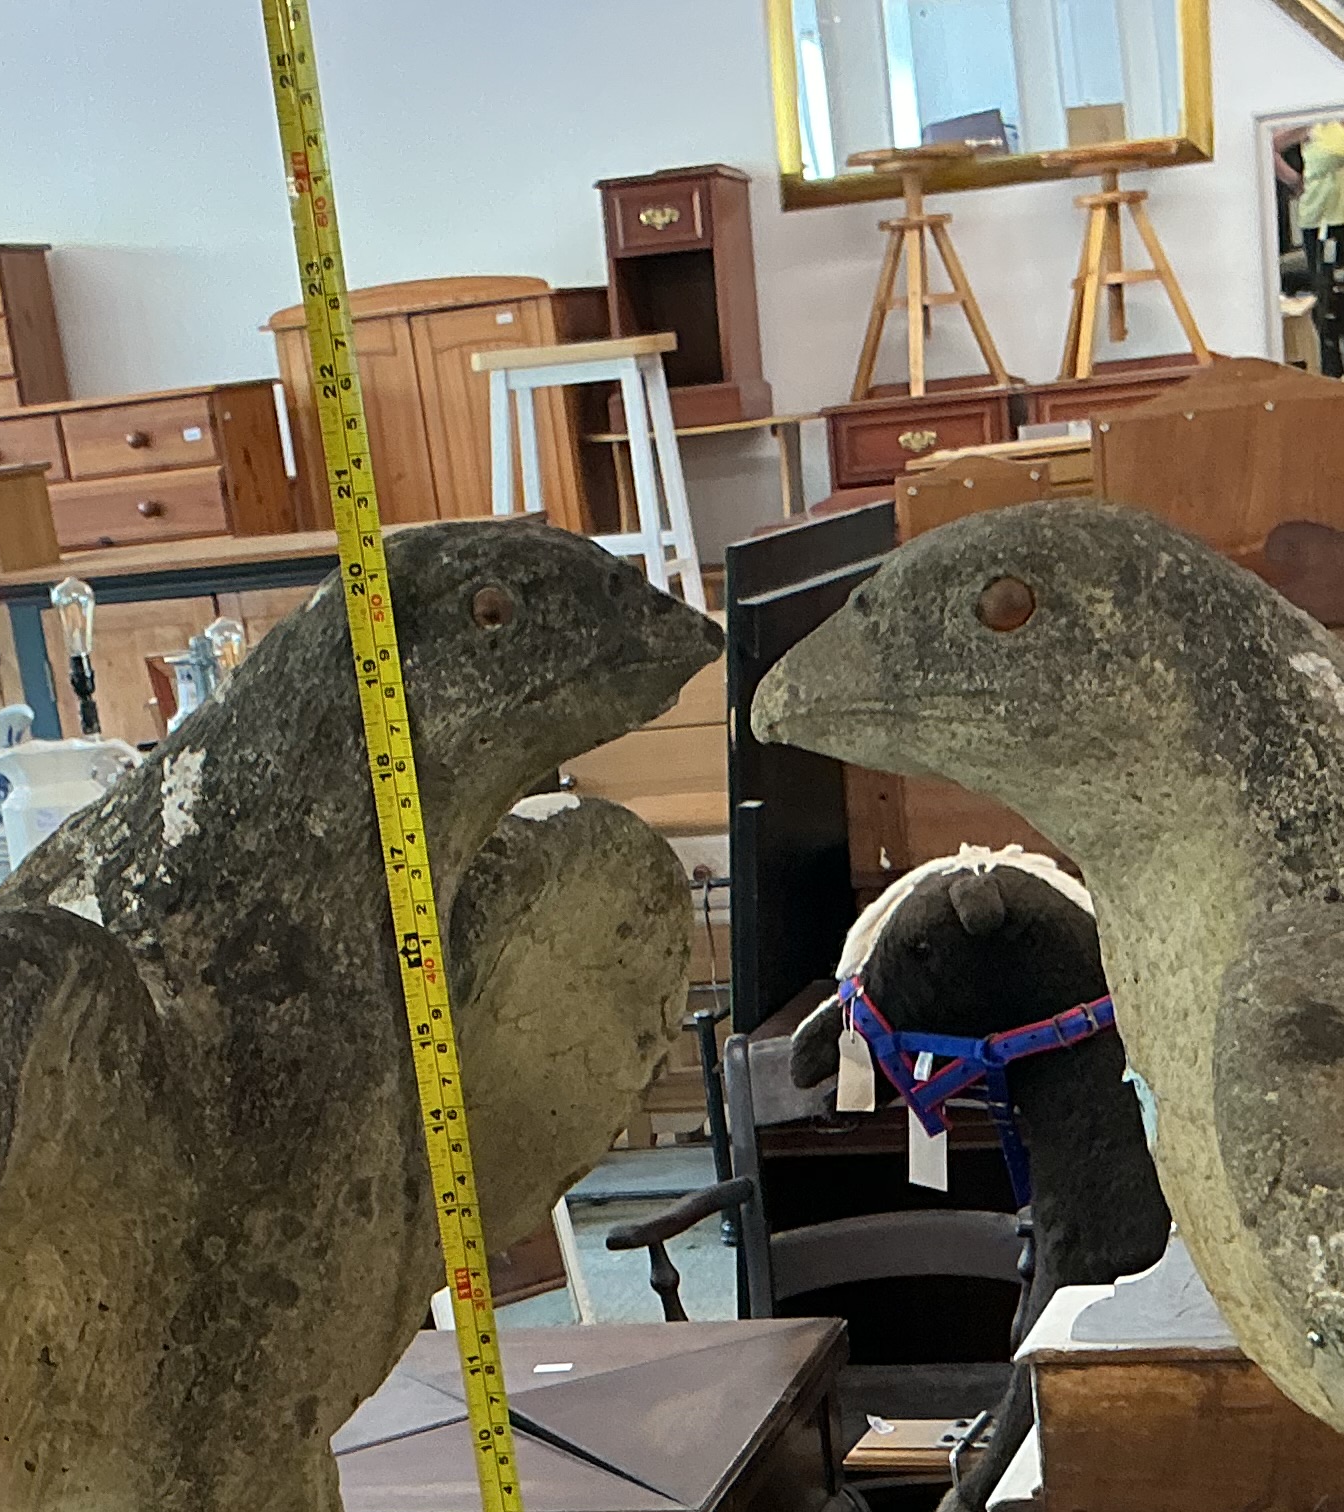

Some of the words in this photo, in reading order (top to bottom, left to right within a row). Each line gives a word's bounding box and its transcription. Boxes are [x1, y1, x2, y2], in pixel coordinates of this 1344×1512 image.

[307, 134, 319, 147] 2
[313, 176, 323, 185] 1
[323, 257, 334, 270] 9
[305, 262, 322, 297] 23
[329, 298, 339, 310] 8
[334, 339, 346, 351] 7
[320, 363, 337, 399] 22
[341, 378, 352, 390] 6
[346, 419, 357, 430] 5
[352, 458, 362, 470] 4
[335, 468, 351, 499] 21
[357, 496, 369, 508] 3
[363, 535, 375, 547] 2
[349, 563, 365, 596] 20
[368, 573, 379, 581] 1
[371, 594, 385, 623] 50
[379, 650, 390, 662] 9
[363, 659, 378, 689] 19
[385, 687, 396, 698] 8
[390, 725, 401, 735] 7
[377, 753, 392, 782] 18
[395, 760, 406, 772] 6
[401, 797, 411, 808] 5
[406, 833, 416, 844] 4
[390, 846, 405, 874] 17
[411, 869, 422, 879] 3
[416, 904, 427, 914] 2
[421, 939, 432, 947] 1
[406, 938, 421, 962] 16
[424, 958, 436, 984] 40
[432, 1009, 442, 1020] 9
[418, 1023, 432, 1050] 15
[437, 1043, 447, 1053] 8
[442, 1077, 452, 1086] 7
[447, 1110, 457, 1120] 6
[430, 1109, 444, 1134] 14
[452, 1143, 462, 1153] 5
[457, 1175, 466, 1185] 4
[442, 1192, 457, 1217] 13
[461, 1208, 472, 1217] 3
[466, 1240, 476, 1250] 2
[480, 1334, 491, 1344] 9
[467, 1356, 481, 1376] 11
[490, 1396, 500, 1404] 7
[494, 1425, 505, 1435] 6
[479, 1429, 492, 1452] 10
[499, 1456, 509, 1465] 5
[504, 1486, 512, 1495] 4
